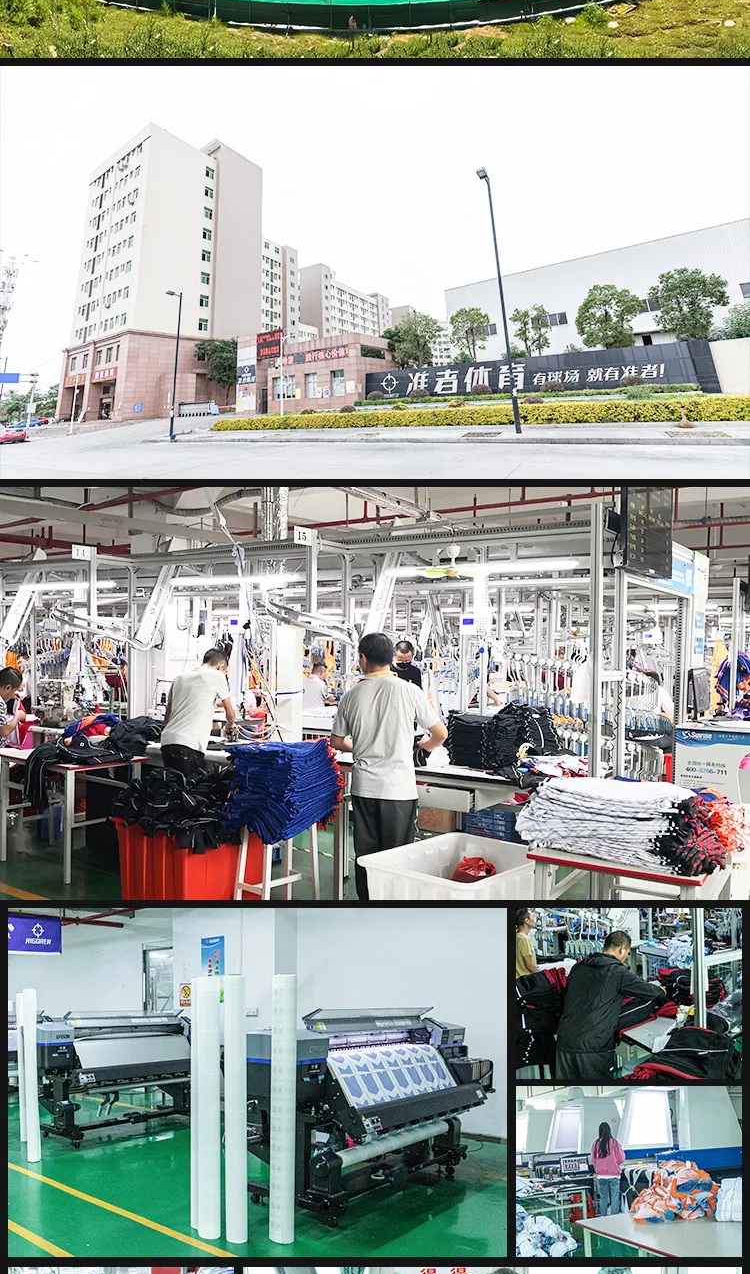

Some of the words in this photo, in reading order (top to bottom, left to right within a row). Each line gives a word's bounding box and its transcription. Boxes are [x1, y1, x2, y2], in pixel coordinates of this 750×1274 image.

[406, 363, 526, 396] 准者体育
[533, 369, 580, 386] 有球场
